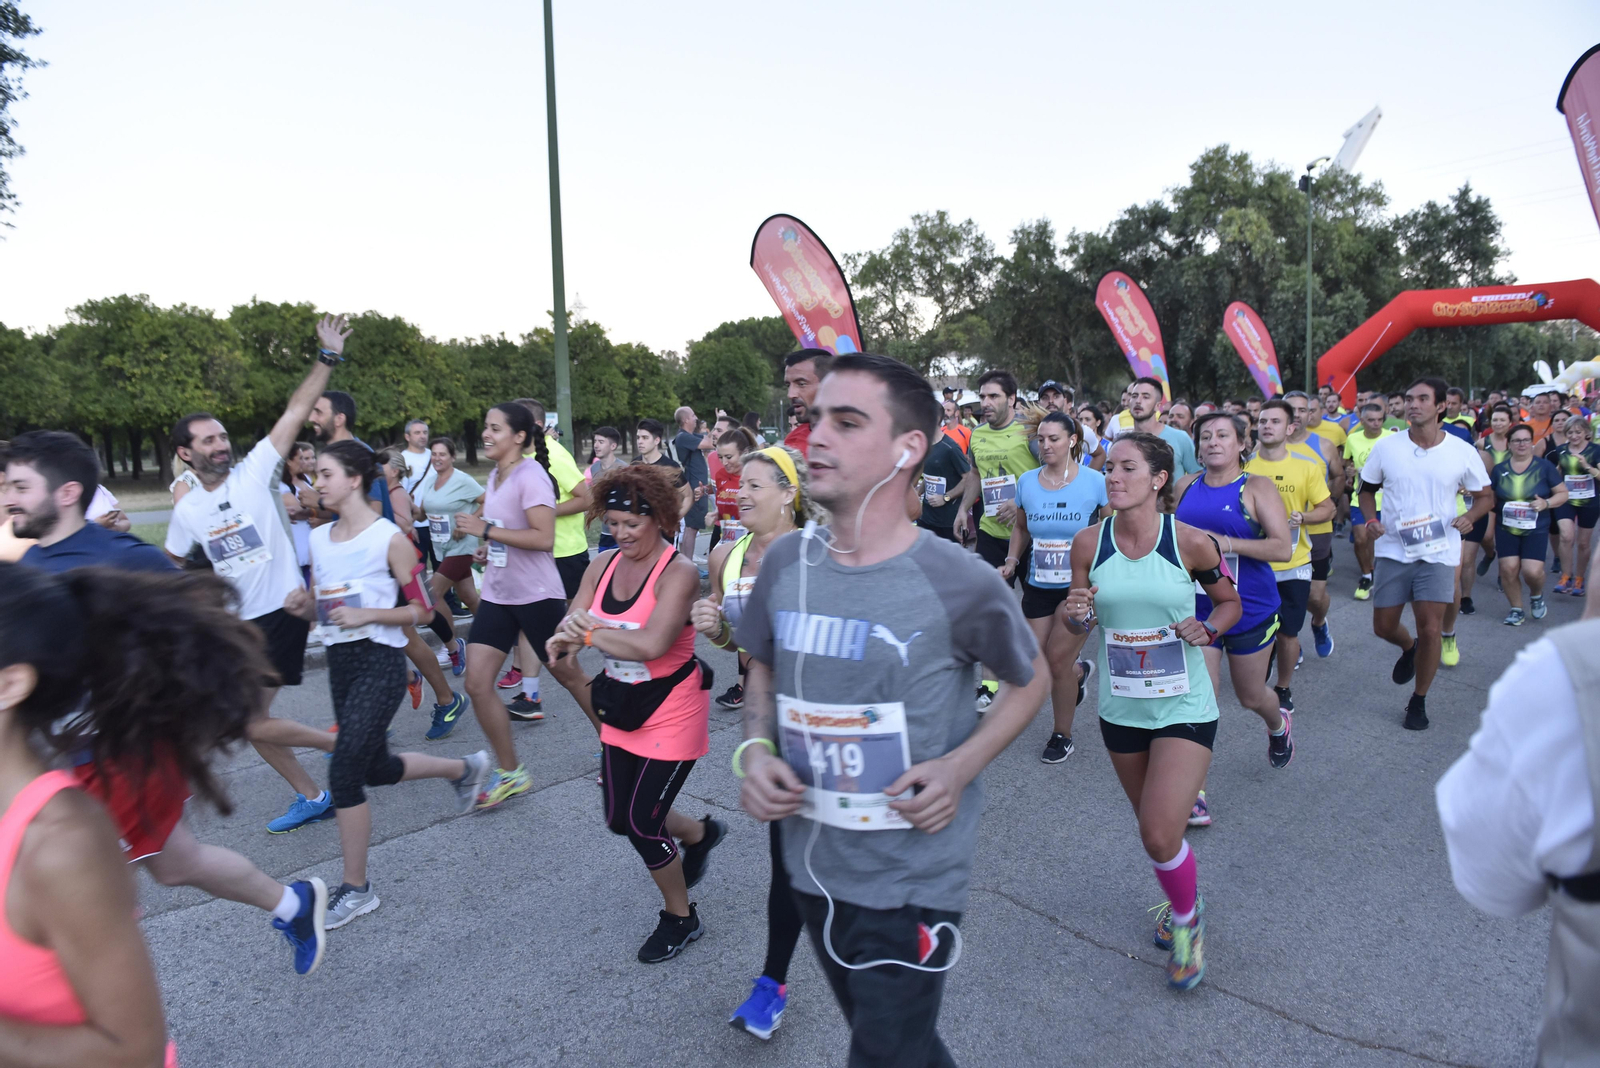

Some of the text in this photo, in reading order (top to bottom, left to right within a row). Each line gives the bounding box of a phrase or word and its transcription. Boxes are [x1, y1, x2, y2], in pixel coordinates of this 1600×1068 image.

[991, 488, 1001, 500] 17
[1028, 511, 1082, 522] #Sevilla10
[1513, 509, 1527, 518] 111
[1412, 524, 1433, 540] 474
[221, 534, 245, 553] 189
[1044, 552, 1065, 566] 417
[1135, 650, 1147, 669] 7
[808, 741, 865, 778] 419
